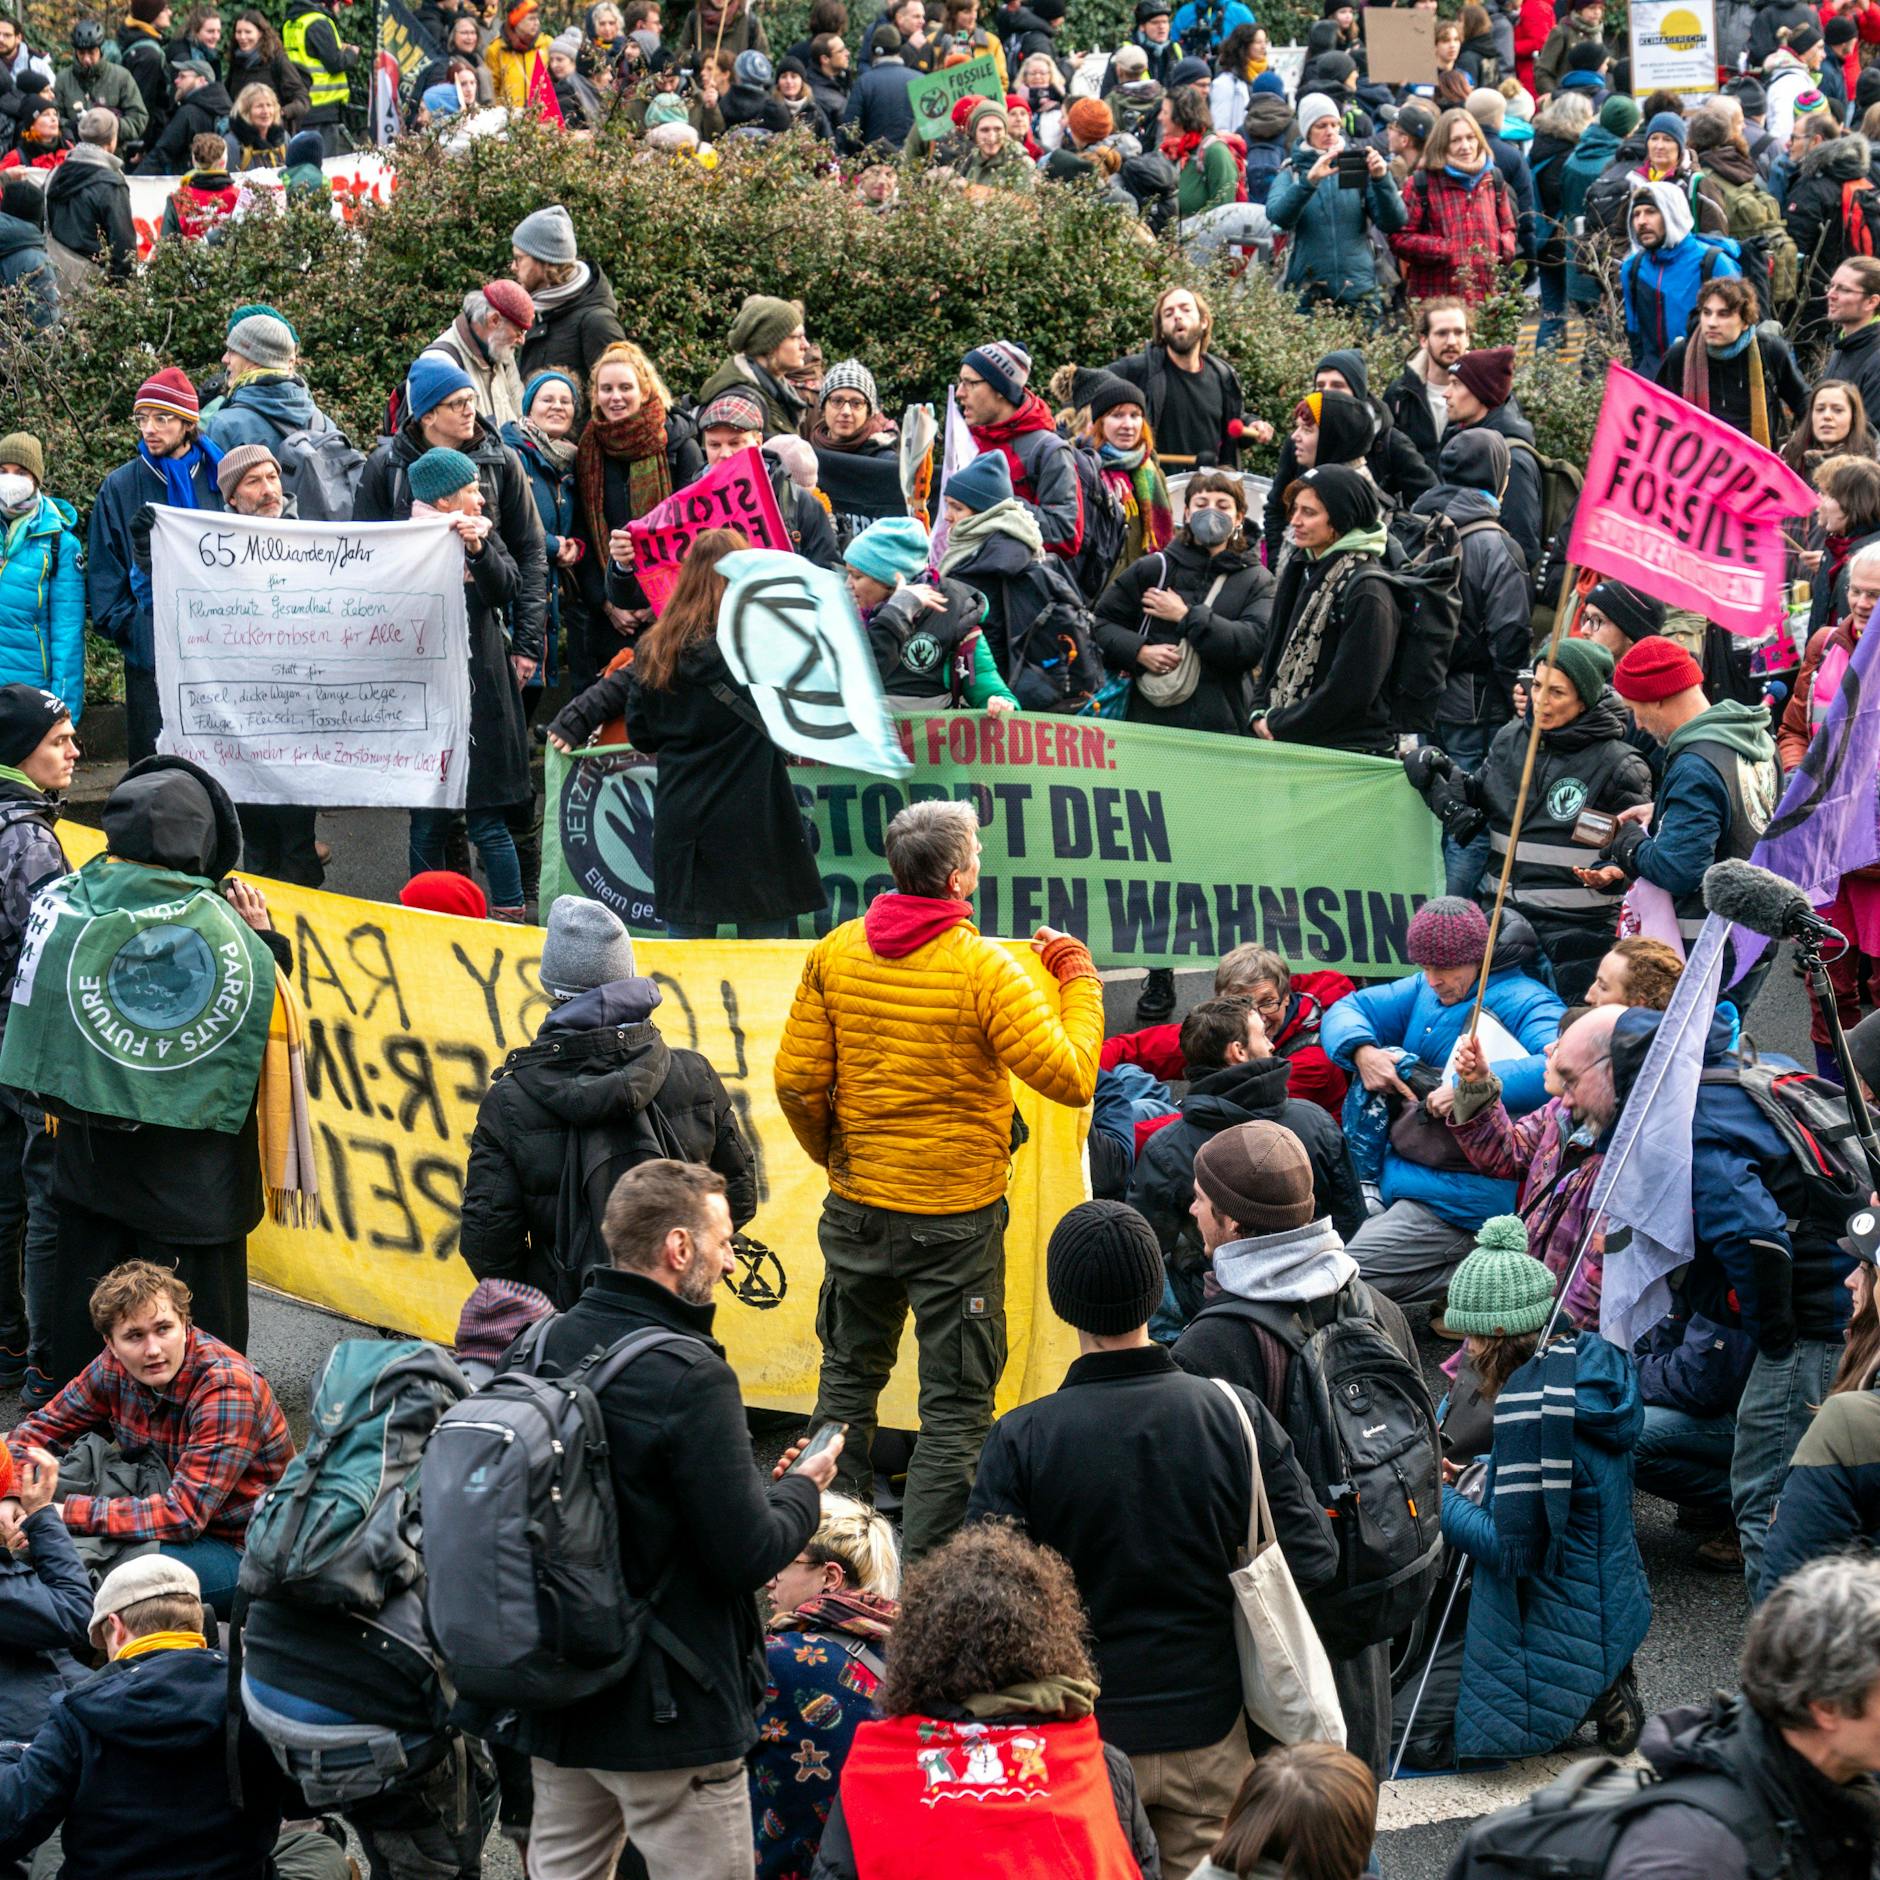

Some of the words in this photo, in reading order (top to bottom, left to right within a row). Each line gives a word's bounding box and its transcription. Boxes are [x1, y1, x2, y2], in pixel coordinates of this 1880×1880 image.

[949, 62, 994, 88] FOSSILE
[1624, 405, 1783, 517] STOPPT
[1604, 456, 1759, 564] FOSSILE
[198, 532, 236, 567] 65
[241, 535, 375, 575] Milliarden/Jahr
[341, 598, 389, 618] Leben
[925, 716, 1118, 770] FORDERN:
[795, 782, 1033, 858] STOPT
[1049, 784, 1172, 863] DEN
[585, 866, 628, 911] Eltern
[631, 901, 665, 923] ge
[78, 975, 150, 1059] FUTURE
[180, 940, 243, 1054] PARENTS
[155, 1038, 174, 1059] 4
